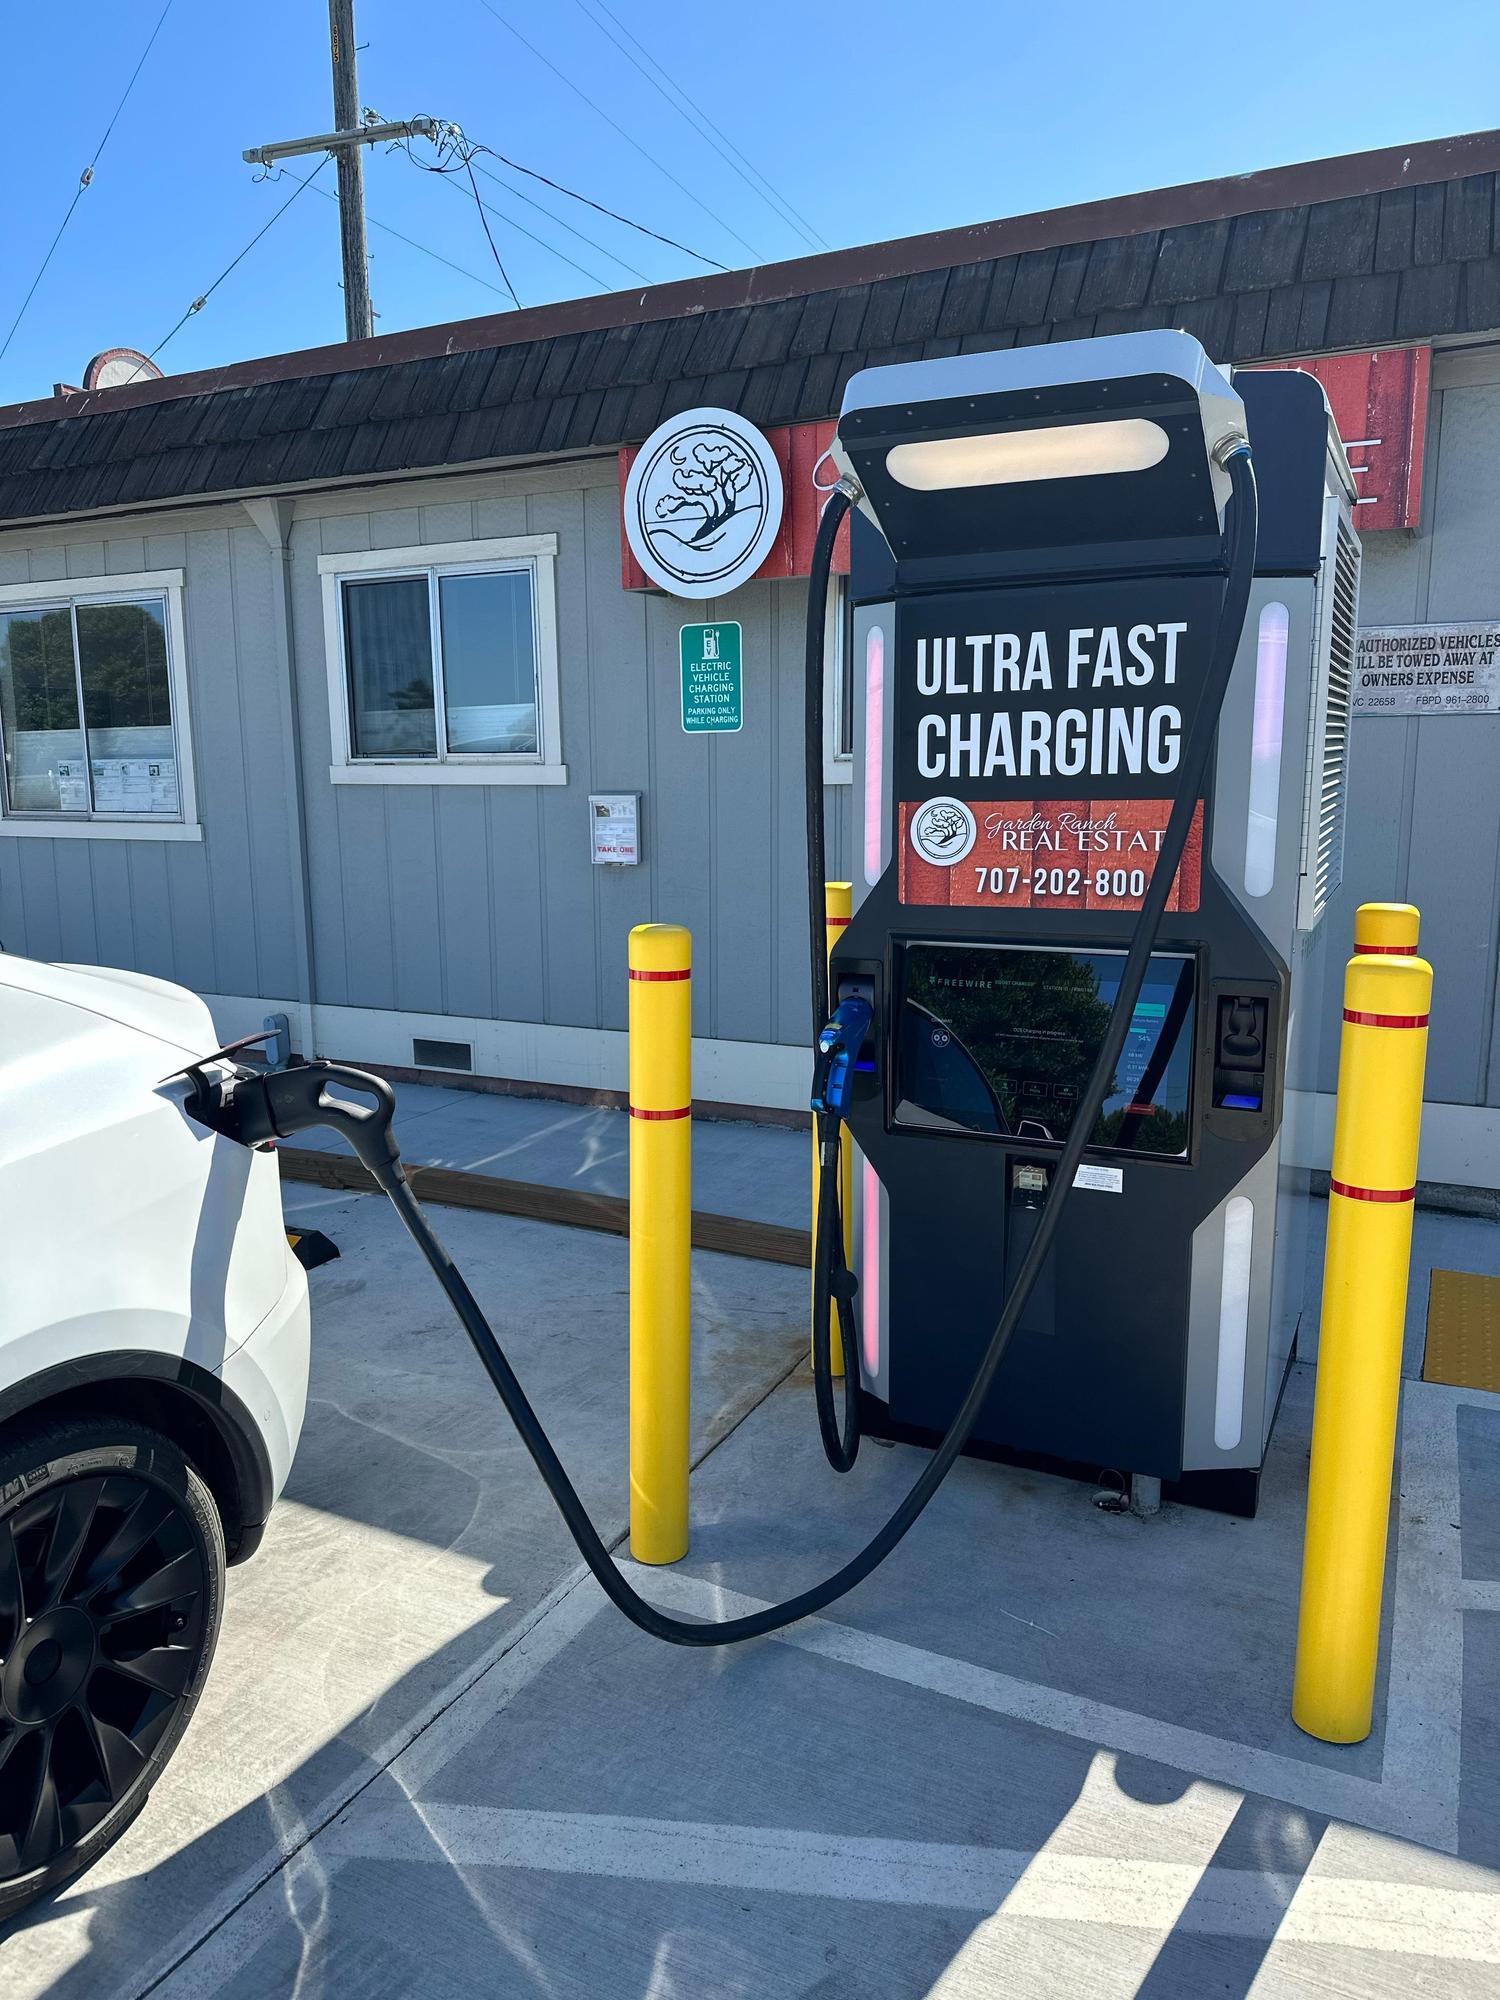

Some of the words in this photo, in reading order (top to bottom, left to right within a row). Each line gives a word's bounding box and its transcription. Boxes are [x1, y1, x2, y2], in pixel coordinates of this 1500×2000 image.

[1357, 637, 1437, 653] AUTHORIZED
[1440, 633, 1500, 650] VEHICLES
[917, 631, 1053, 696] ULTRA
[1067, 622, 1188, 688] FAST
[1356, 655, 1375, 669] ILL
[1378, 655, 1394, 669] BE
[1396, 653, 1441, 668] TOWED
[1443, 652, 1477, 666] AWAY
[1479, 651, 1495, 665] AT
[690, 661, 732, 672] ELECTRIC
[692, 672, 730, 682] VEHICLE
[1361, 672, 1414, 687] OWNERS
[1416, 671, 1475, 685] EXPENSE
[688, 683, 734, 693] CHARGING
[693, 694, 730, 704] STATION
[1367, 697, 1396, 707] 22658
[1416, 696, 1442, 705] FBPD
[1445, 694, 1490, 705] 961-2800
[687, 707, 716, 715] PARKING
[717, 706, 736, 714] ONLY
[685, 716, 705, 724] WHILE
[706, 715, 739, 724] CHARGING
[917, 704, 1182, 779] CHARGING
[984, 812, 1053, 839] Garden
[1057, 812, 1118, 834] Ranch
[1002, 830, 1069, 851] REAL
[1078, 829, 1168, 851] ESTAT
[974, 867, 1150, 897] 707-202-800
[937, 977, 993, 989] FREEWIRE
